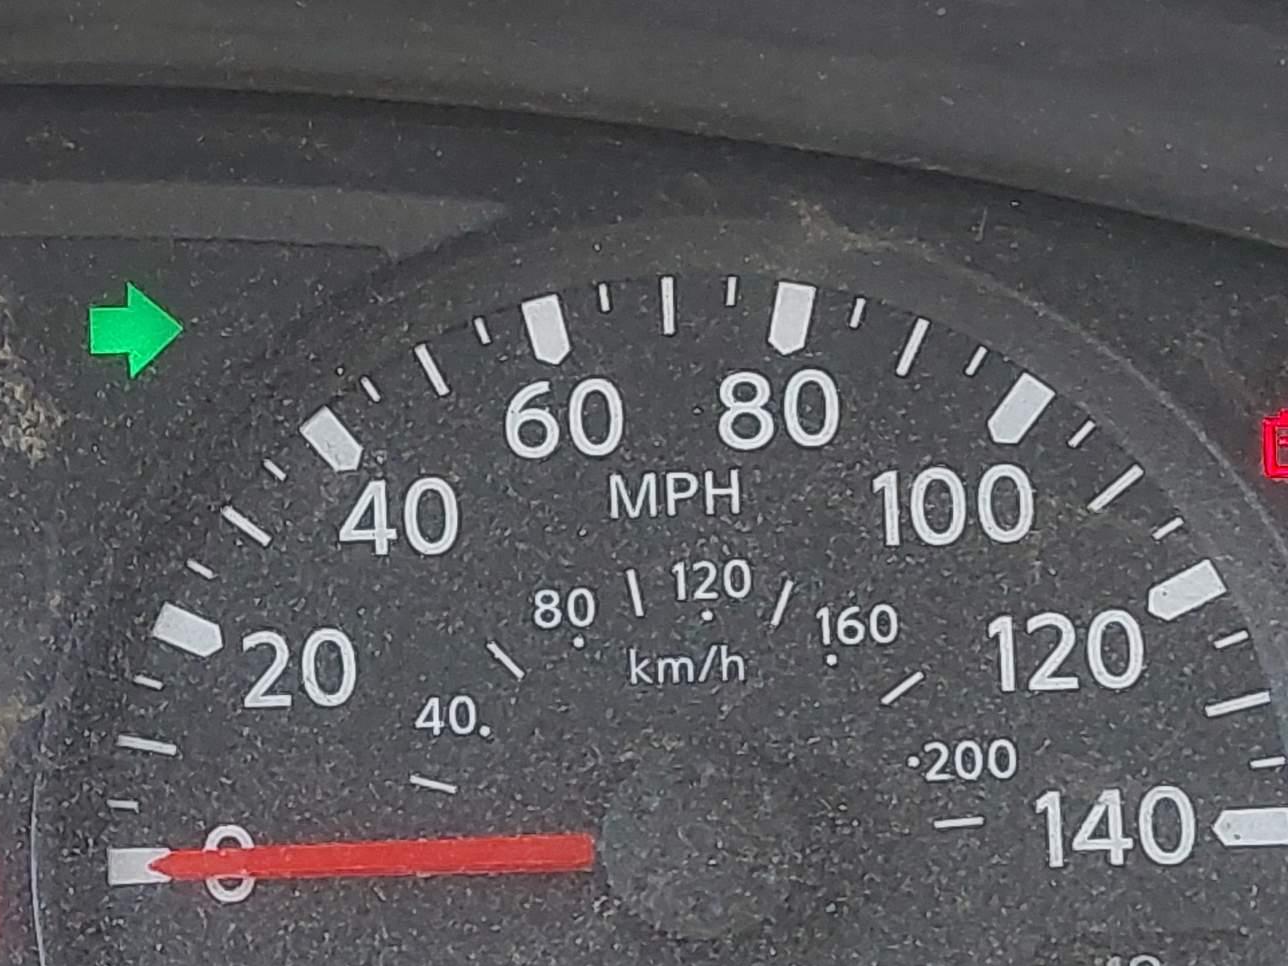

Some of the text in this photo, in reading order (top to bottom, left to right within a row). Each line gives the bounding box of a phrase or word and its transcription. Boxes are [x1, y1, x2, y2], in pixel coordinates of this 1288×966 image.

[505, 377, 624, 460] 60
[718, 368, 840, 450] 80
[339, 476, 459, 557] 40
[609, 469, 742, 519] MPH
[872, 463, 1035, 546] 100
[533, 587, 597, 629] 80
[672, 559, 753, 602] 120
[629, 644, 748, 686] km/h
[816, 603, 899, 646] 160
[987, 609, 1144, 692] 120
[242, 627, 357, 709] 20
[924, 739, 1018, 782] 200
[1036, 785, 1196, 868] 140
